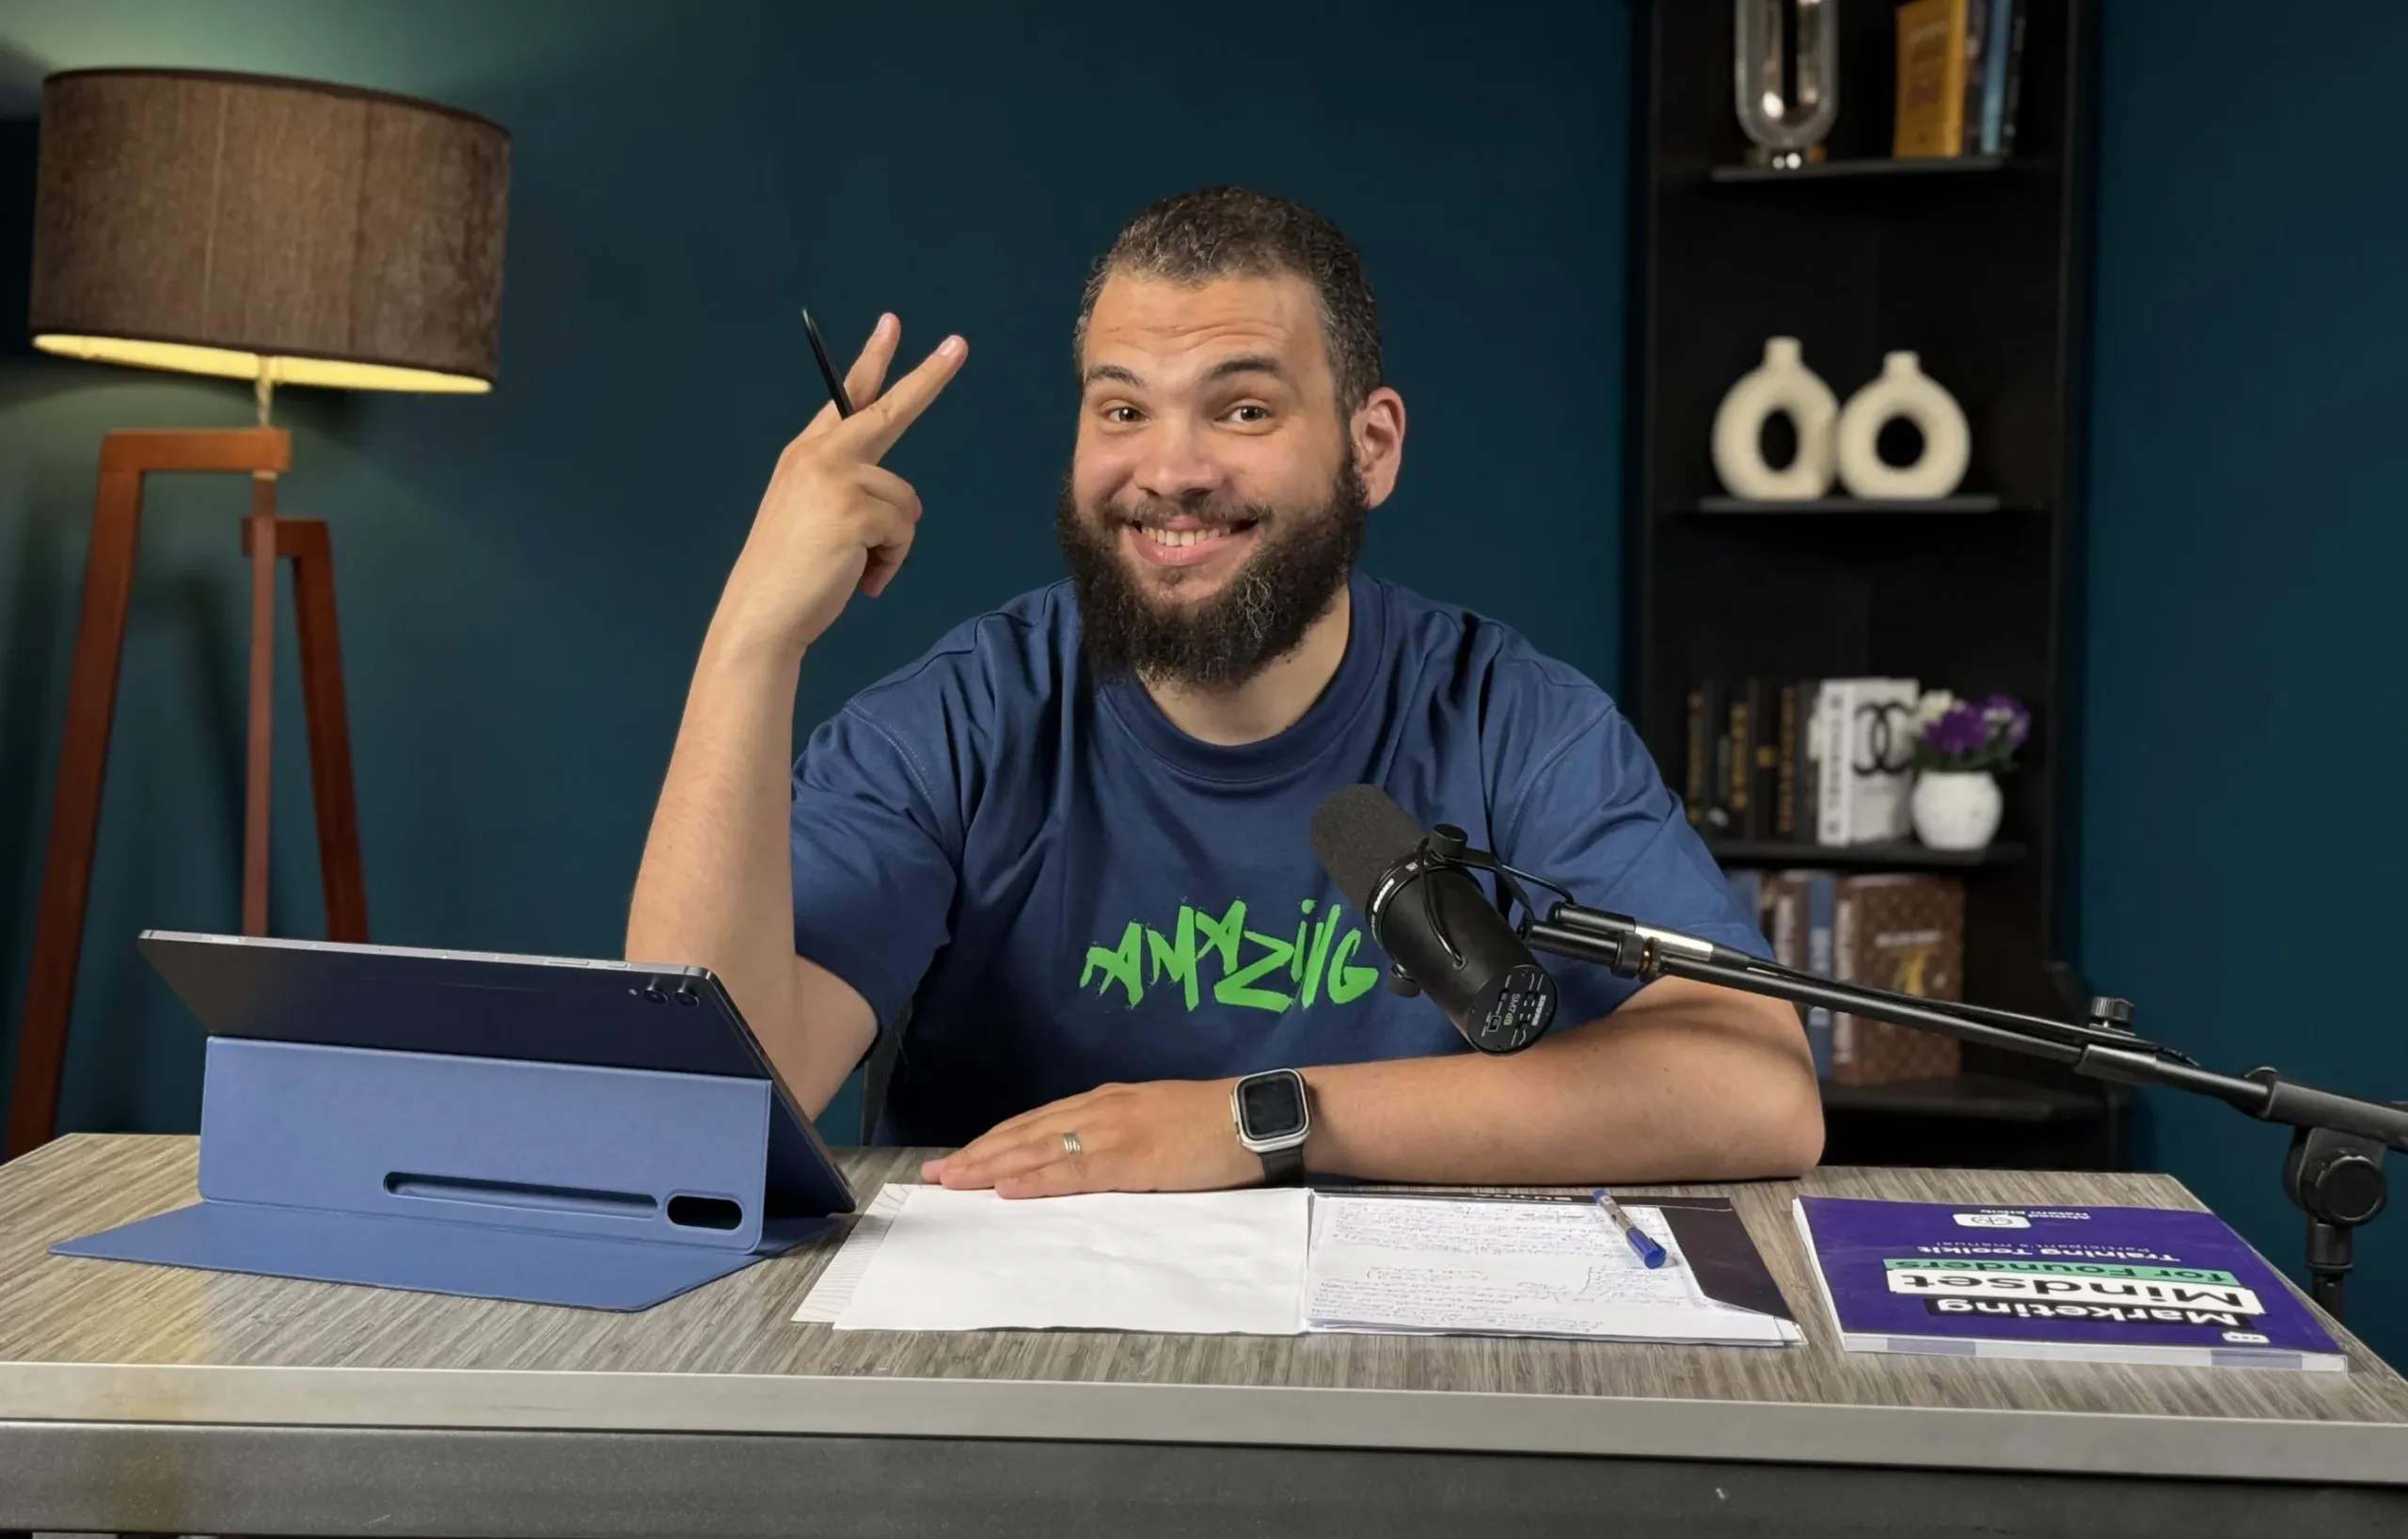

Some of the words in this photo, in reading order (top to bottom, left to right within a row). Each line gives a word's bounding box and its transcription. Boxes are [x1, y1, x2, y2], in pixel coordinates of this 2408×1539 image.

[1917, 1245, 2034, 1256] Toolkit
[2040, 1247, 2182, 1262] Training
[1895, 1261, 2137, 1277] Founders
[2154, 1270, 2226, 1282] for
[1901, 1275, 2244, 1308] Mindset
[1938, 1299, 2241, 1326] Marketing
